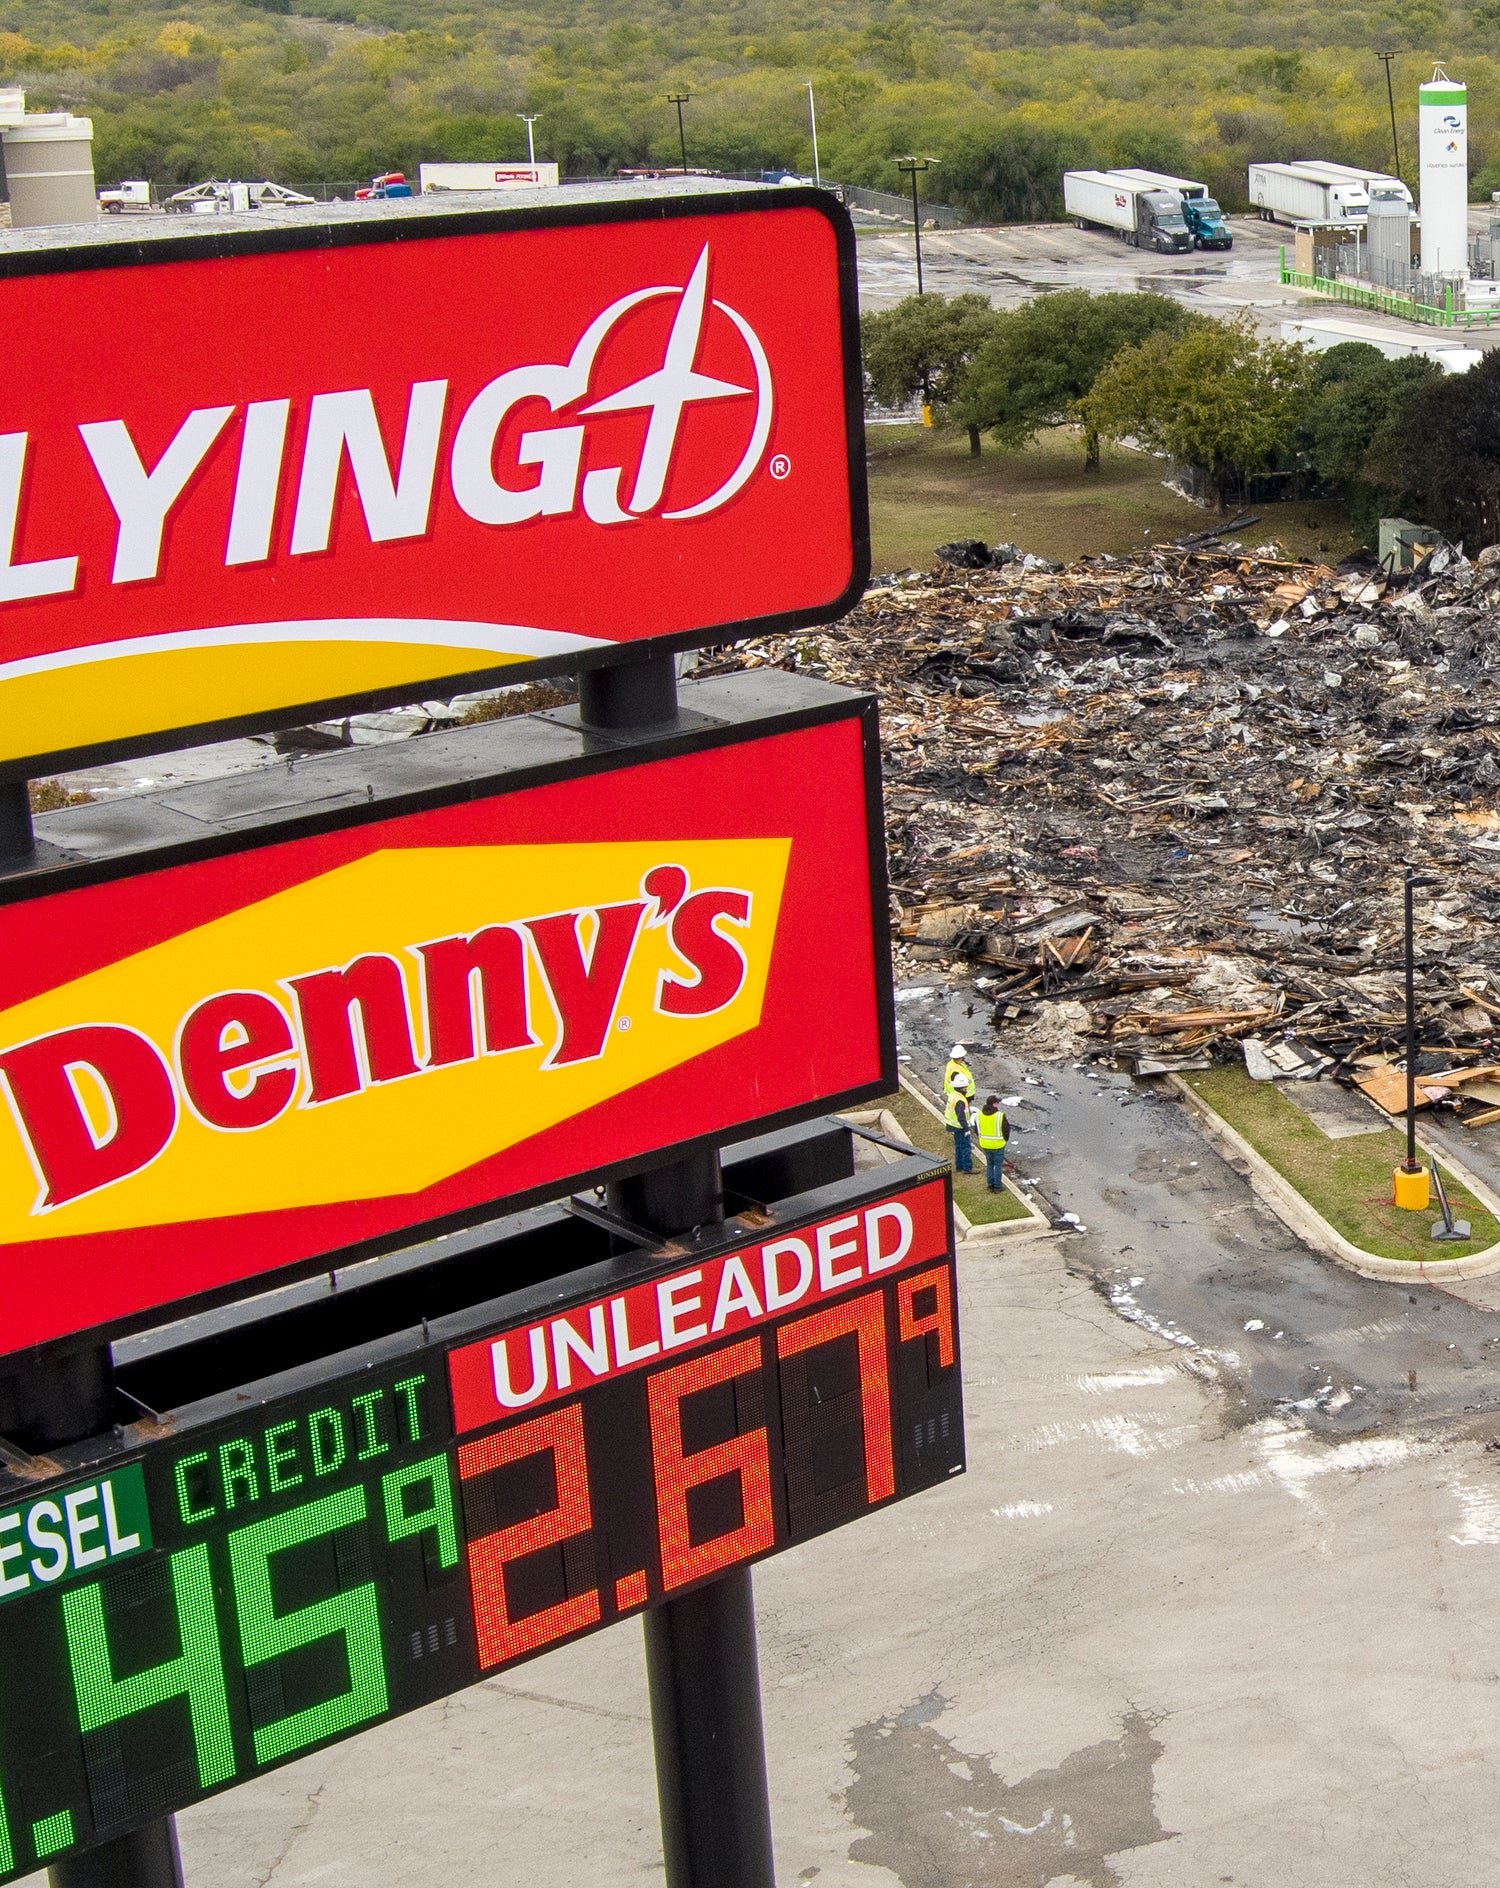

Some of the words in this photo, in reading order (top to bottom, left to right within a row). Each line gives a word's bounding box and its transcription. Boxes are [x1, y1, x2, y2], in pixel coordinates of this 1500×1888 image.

[0, 864, 753, 1217] Denny's
[916, 1164, 952, 1181] SUNSHINE
[491, 1202, 914, 1409] UNLEADED
[174, 1374, 425, 1525] CREDIT
[0, 1480, 141, 1597] ESEL
